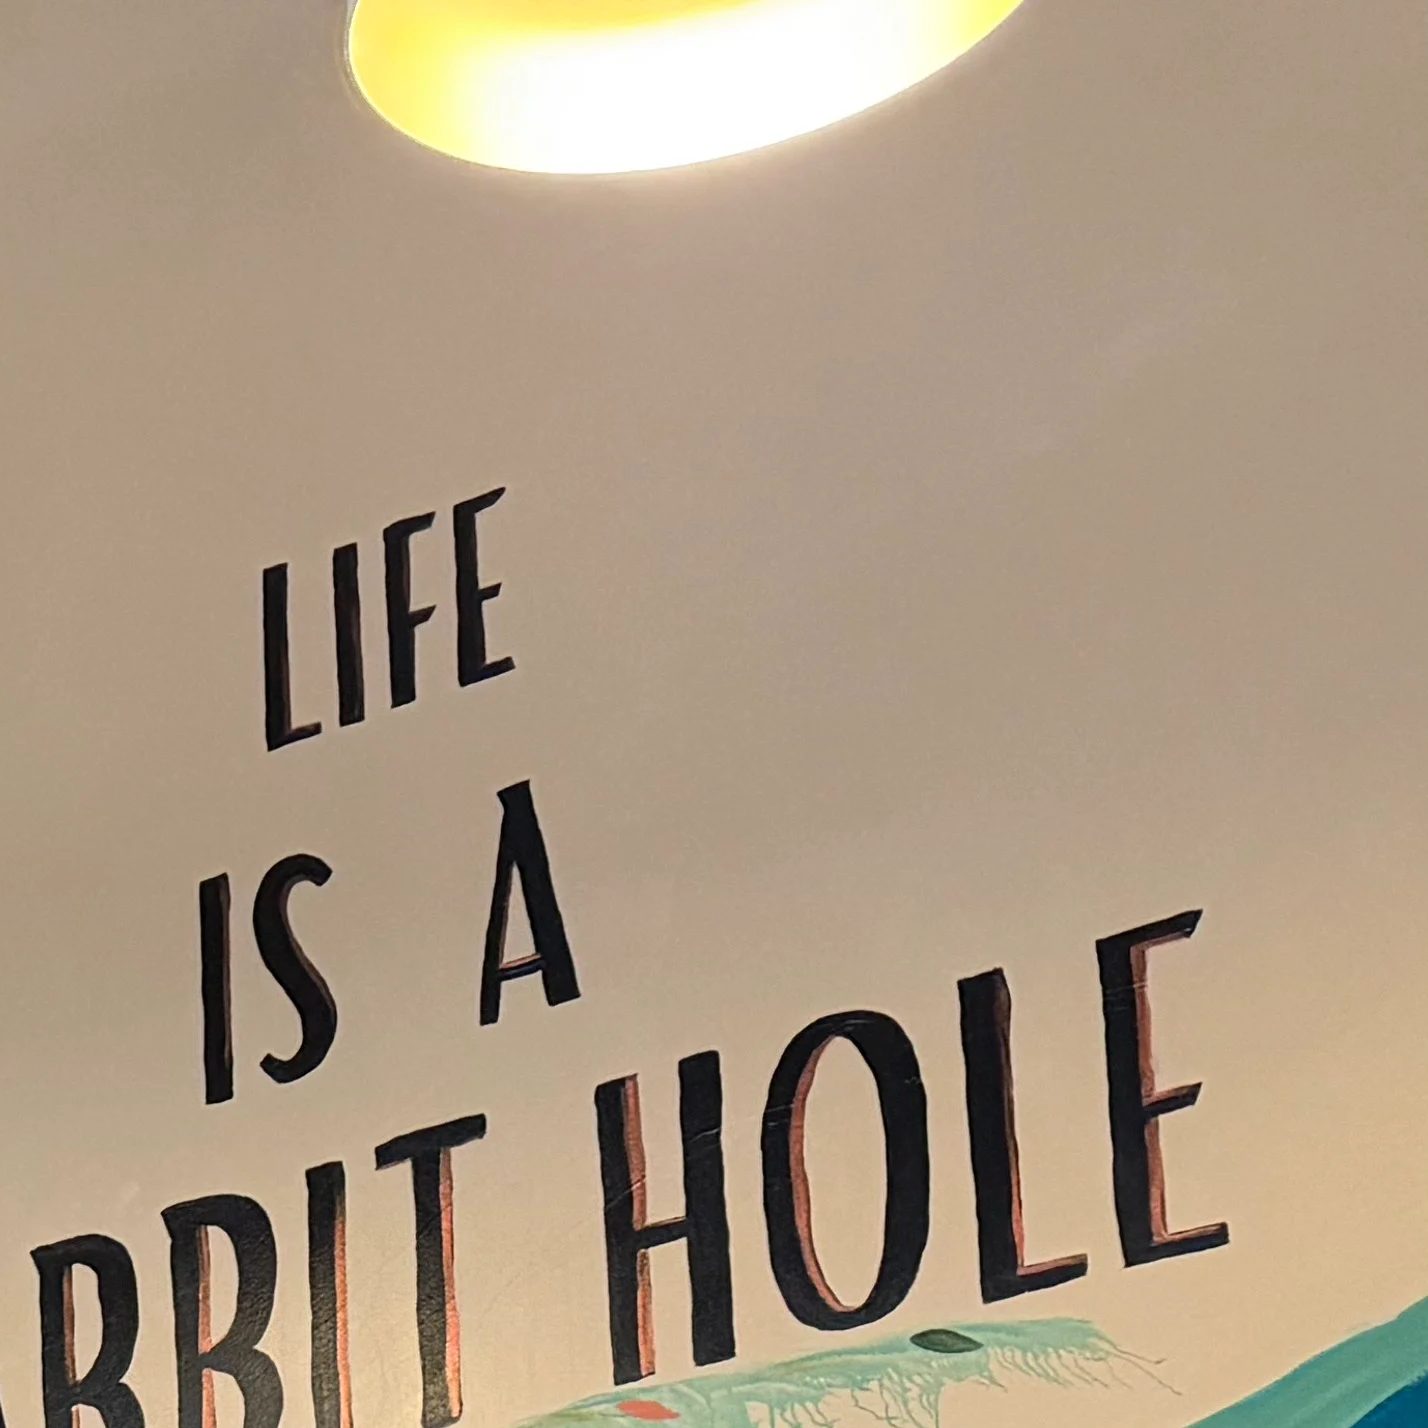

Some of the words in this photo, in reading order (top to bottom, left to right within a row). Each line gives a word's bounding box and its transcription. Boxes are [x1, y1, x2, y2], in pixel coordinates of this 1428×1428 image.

[261, 485, 517, 753] LIFE
[197, 852, 339, 1106] IS
[478, 778, 582, 1027] A
[592, 907, 1231, 1387] HOLE
